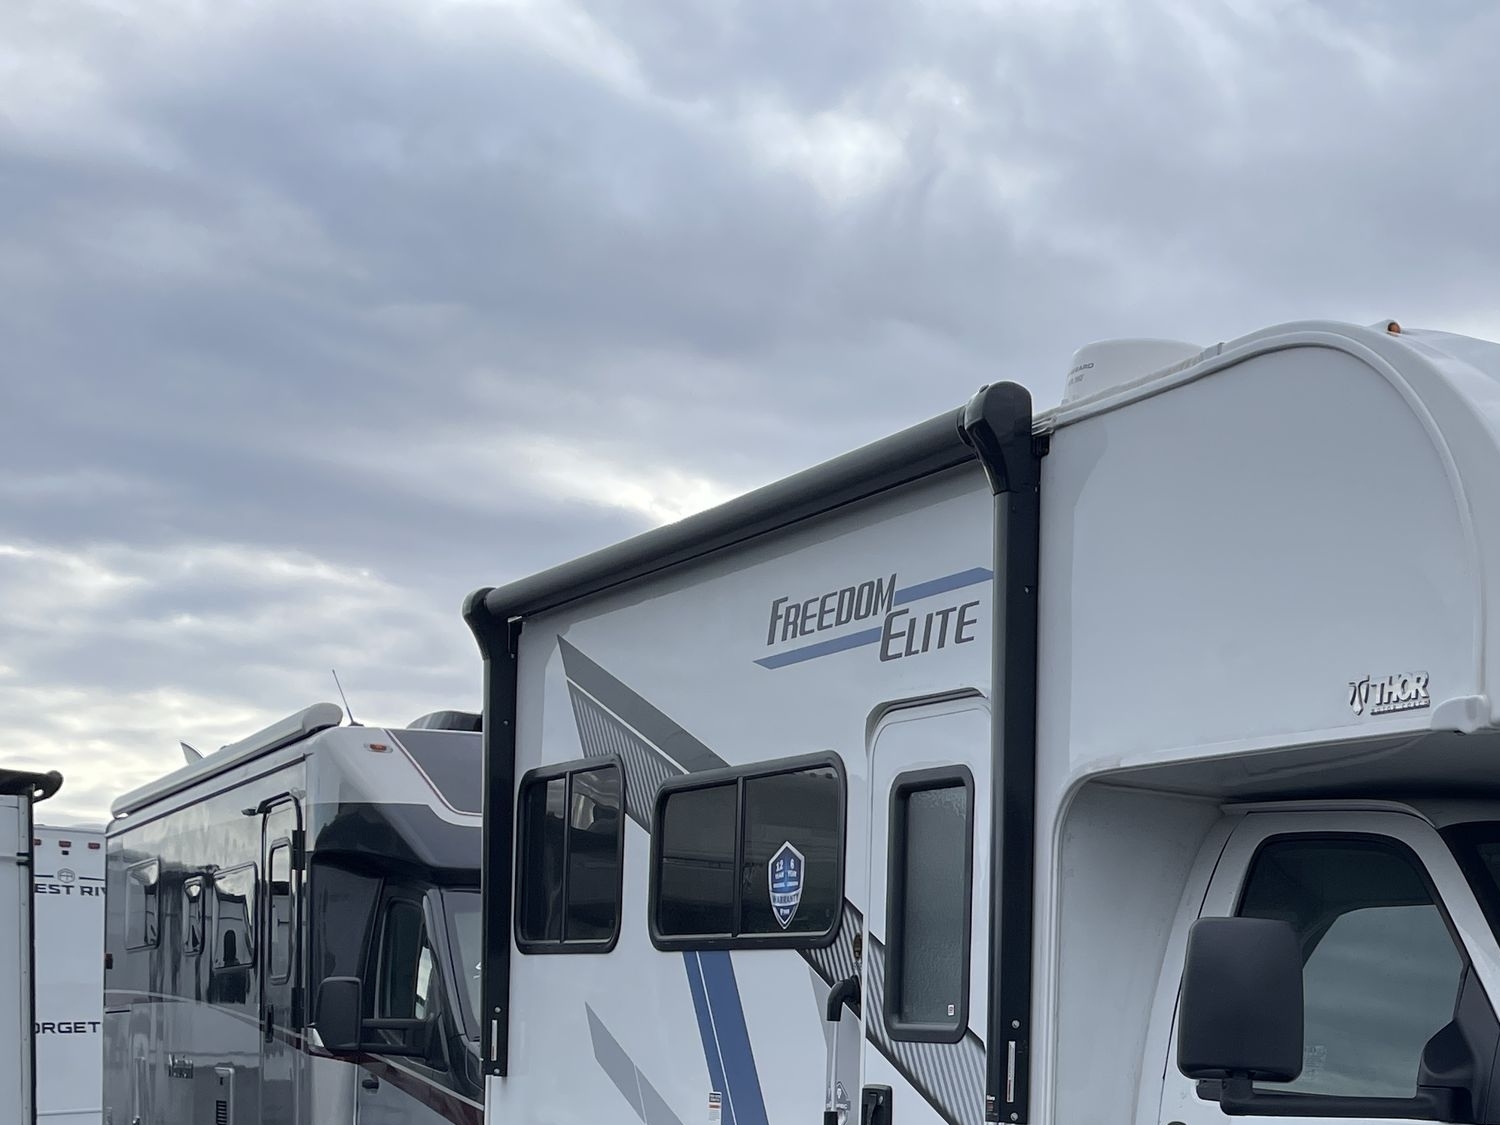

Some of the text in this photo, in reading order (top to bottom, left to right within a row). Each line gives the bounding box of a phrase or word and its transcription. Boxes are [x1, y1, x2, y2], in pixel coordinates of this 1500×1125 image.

[767, 573, 897, 646] FREEDOM
[879, 600, 980, 662] ELITE
[1371, 672, 1430, 706] THOR
